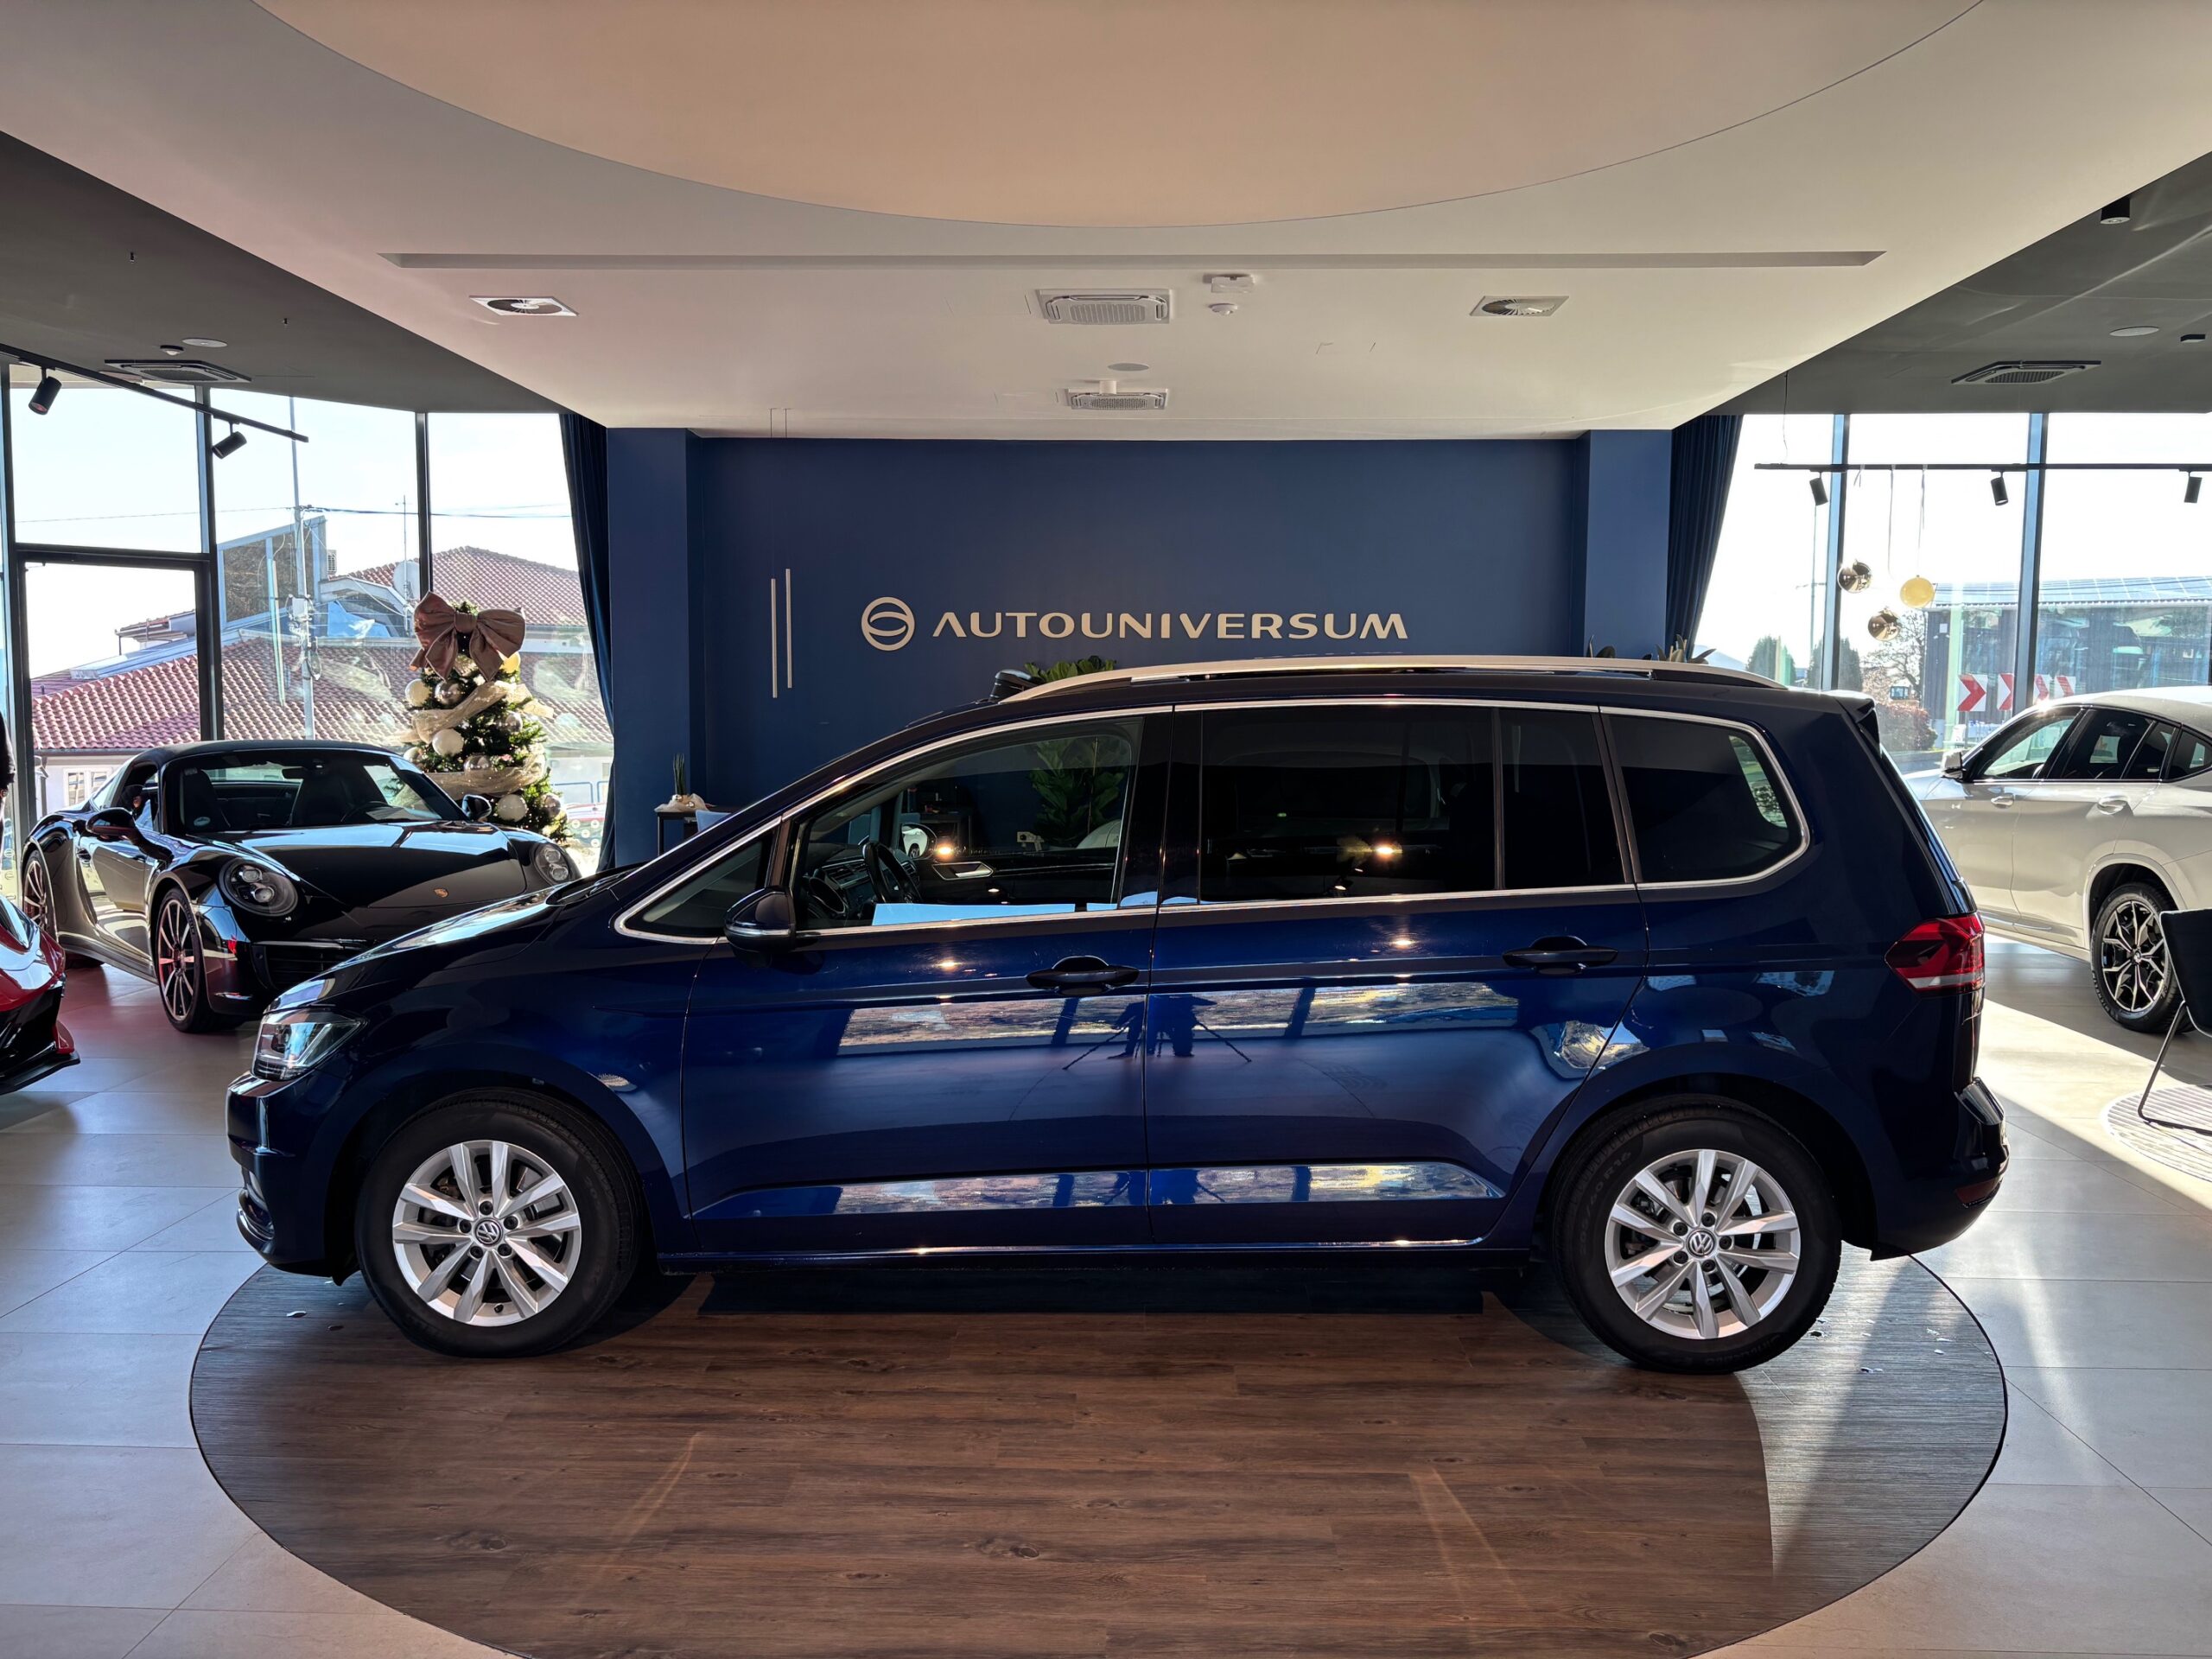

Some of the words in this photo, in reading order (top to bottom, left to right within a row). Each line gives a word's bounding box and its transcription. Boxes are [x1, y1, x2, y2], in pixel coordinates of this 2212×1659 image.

[932, 612, 1408, 639] AUTOUNIVERSUM
[477, 1221, 499, 1244] VW
[1689, 1231, 1714, 1255] VW
